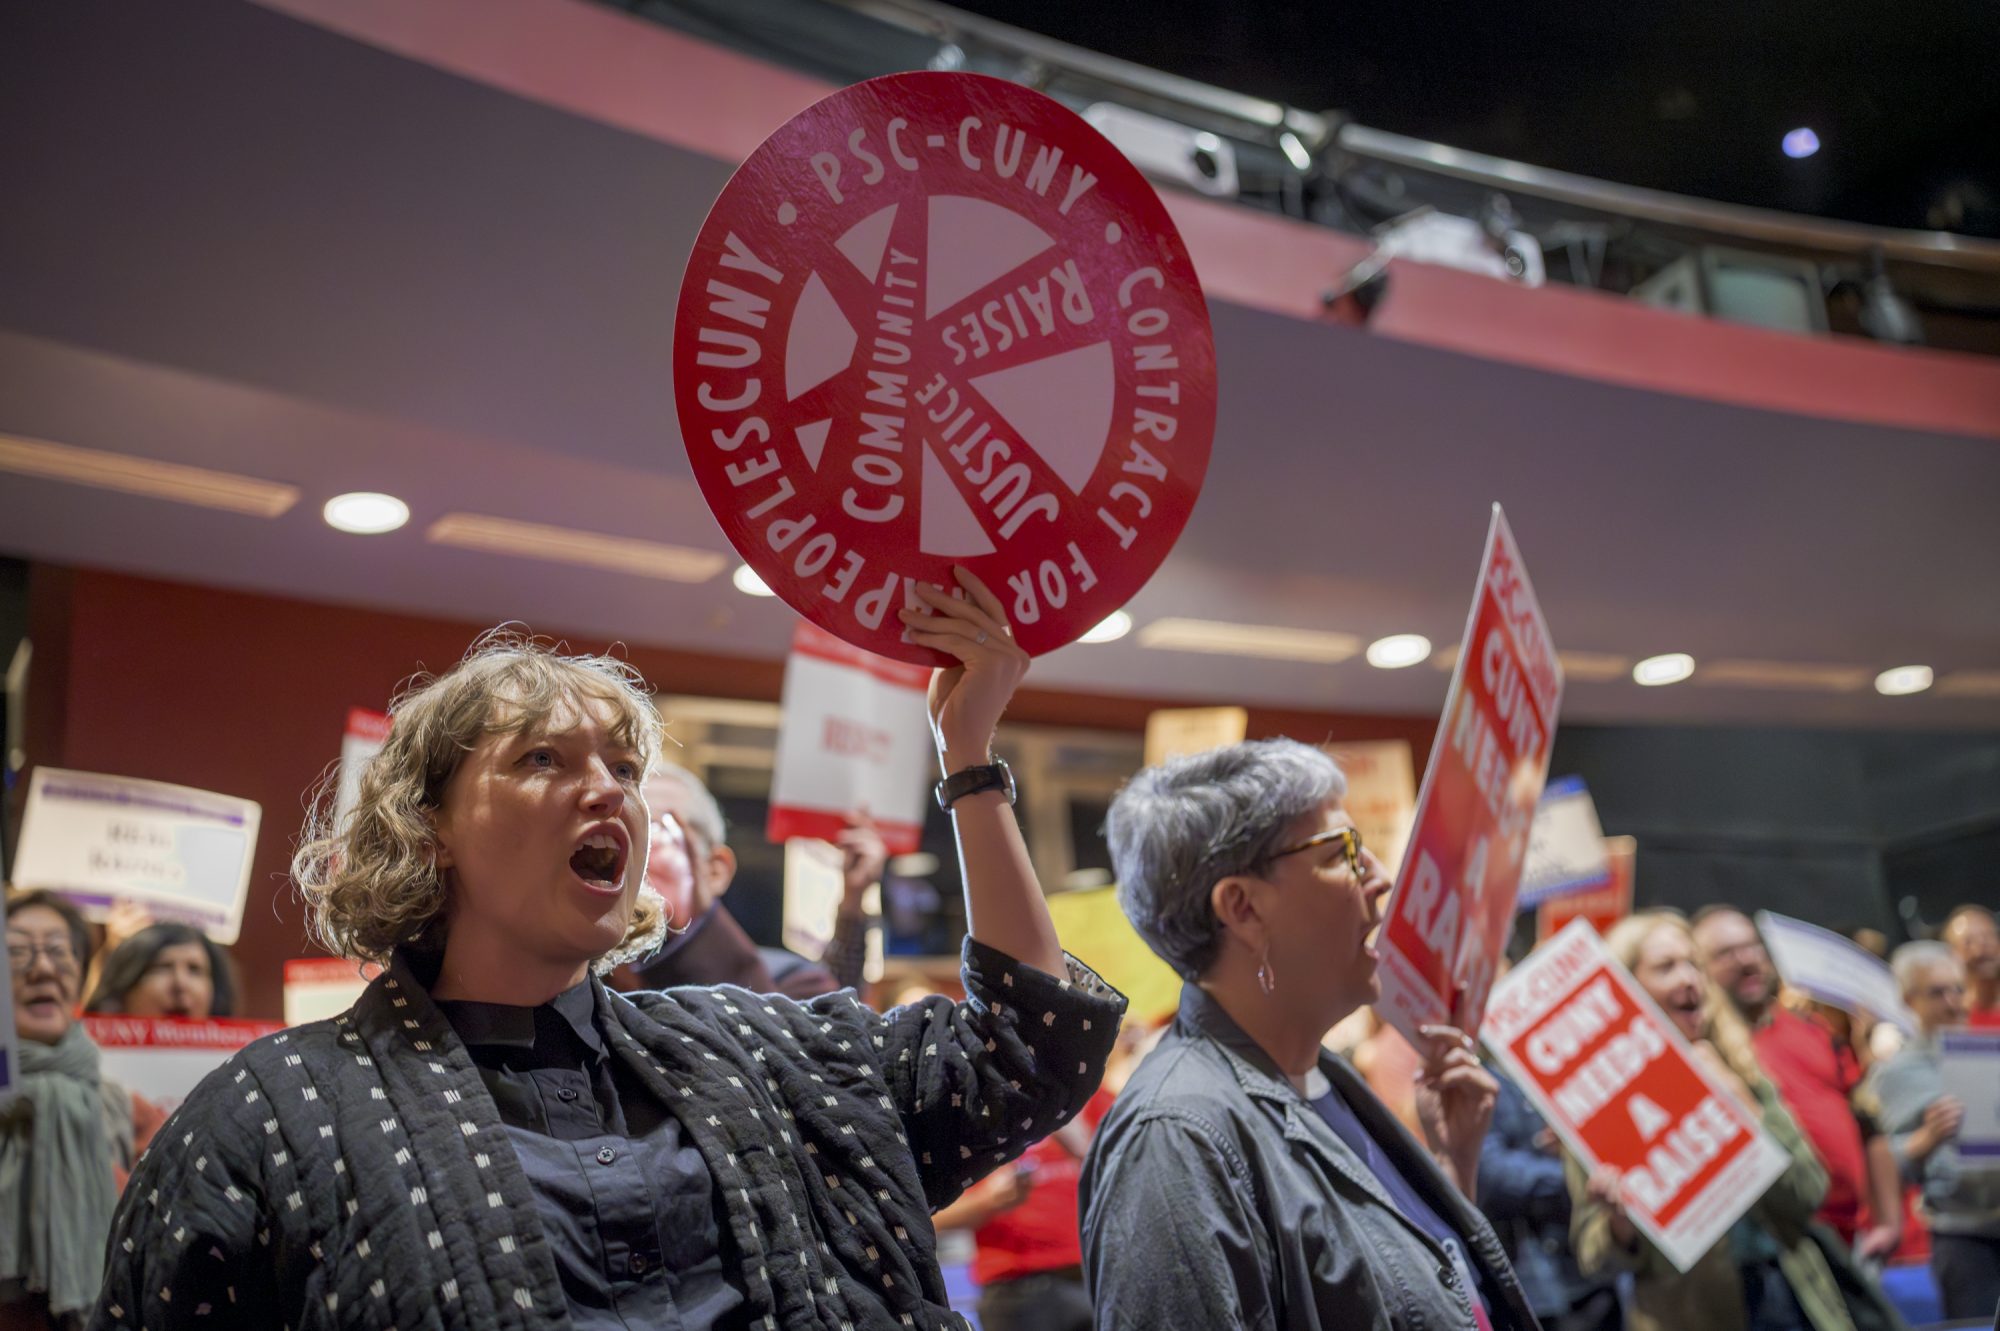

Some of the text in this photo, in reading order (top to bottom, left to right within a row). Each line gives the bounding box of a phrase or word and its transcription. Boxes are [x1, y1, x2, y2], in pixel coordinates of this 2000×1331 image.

[810, 115, 1098, 215] PSC-CUNY
[941, 259, 1095, 366] RAISES
[842, 247, 920, 522] COMMUNITY
[1096, 265, 1180, 550] CONTRACT
[915, 372, 1060, 541] JUSTICE
[1006, 541, 1098, 625] FOR
[1482, 628, 1541, 758] CUNY
[1525, 975, 1623, 1076] CUNY
[1551, 1013, 1666, 1128] NEEDS
[1621, 1096, 1740, 1211] RAISE
[1626, 1091, 1672, 1144] A
